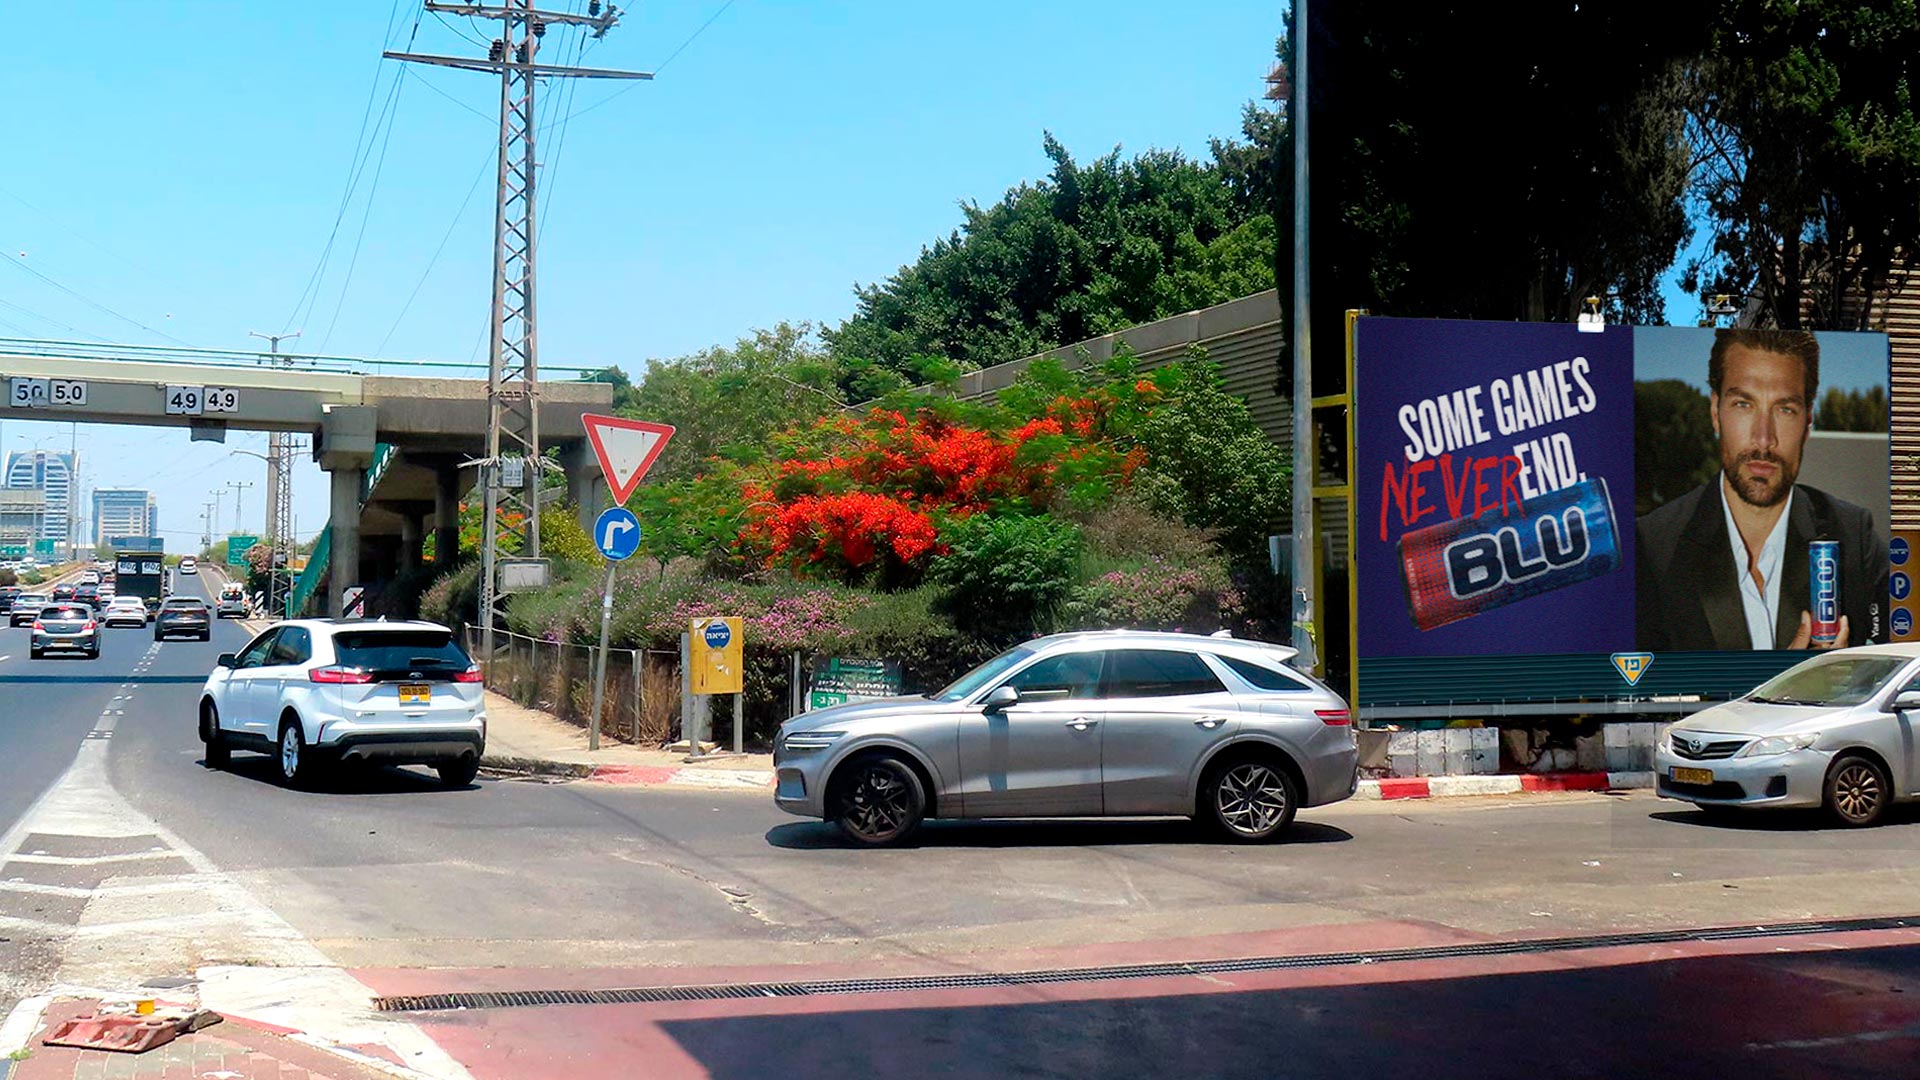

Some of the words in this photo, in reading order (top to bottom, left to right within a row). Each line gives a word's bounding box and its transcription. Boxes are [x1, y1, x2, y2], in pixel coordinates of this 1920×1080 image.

[55, 385, 83, 400] 5.0
[170, 393, 197, 409] 4.9
[208, 391, 235, 407] 4.9
[1398, 385, 1491, 462] SOME
[1490, 356, 1596, 436] GAMES
[1380, 453, 1527, 541] NEVER
[1514, 432, 1587, 500] END.
[1443, 505, 1591, 601] BLU
[1817, 557, 1837, 624] BLU
[1894, 577, 1906, 595] P
[1624, 659, 1640, 671] פז
